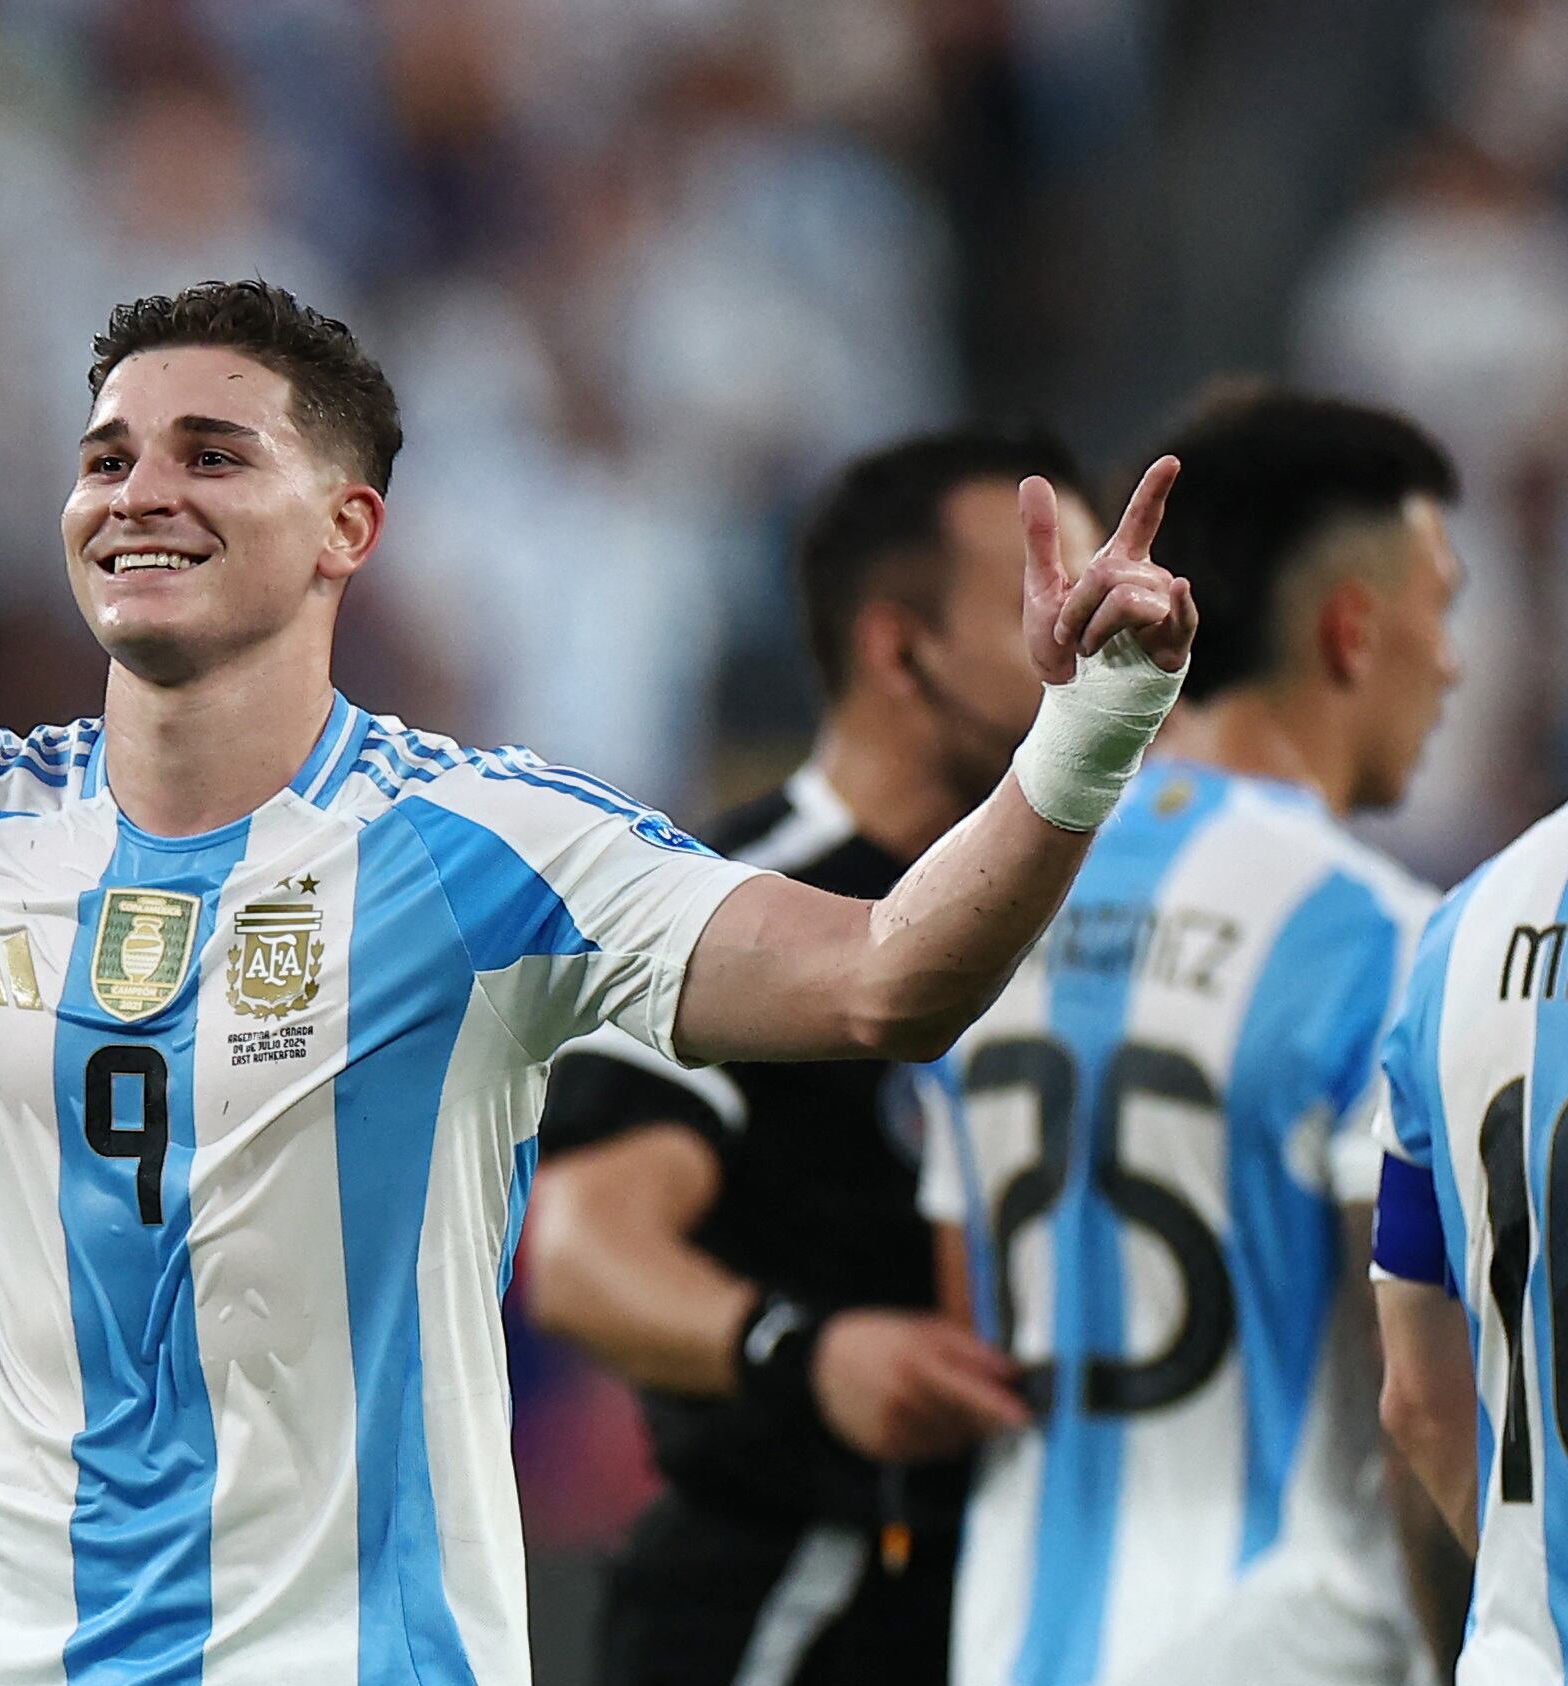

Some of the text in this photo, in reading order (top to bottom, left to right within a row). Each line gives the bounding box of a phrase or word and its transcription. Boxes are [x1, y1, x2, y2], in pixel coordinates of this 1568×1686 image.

[245, 933, 302, 986] AFA
[228, 1030, 270, 1044] ARGENTINA
[280, 1026, 314, 1037] CANADA
[233, 1038, 306, 1054] 09 DE JULIO 2024
[232, 1049, 306, 1066] EAST RUTHERFORD
[83, 1044, 168, 1225] 9
[964, 1035, 1234, 1424] 25
